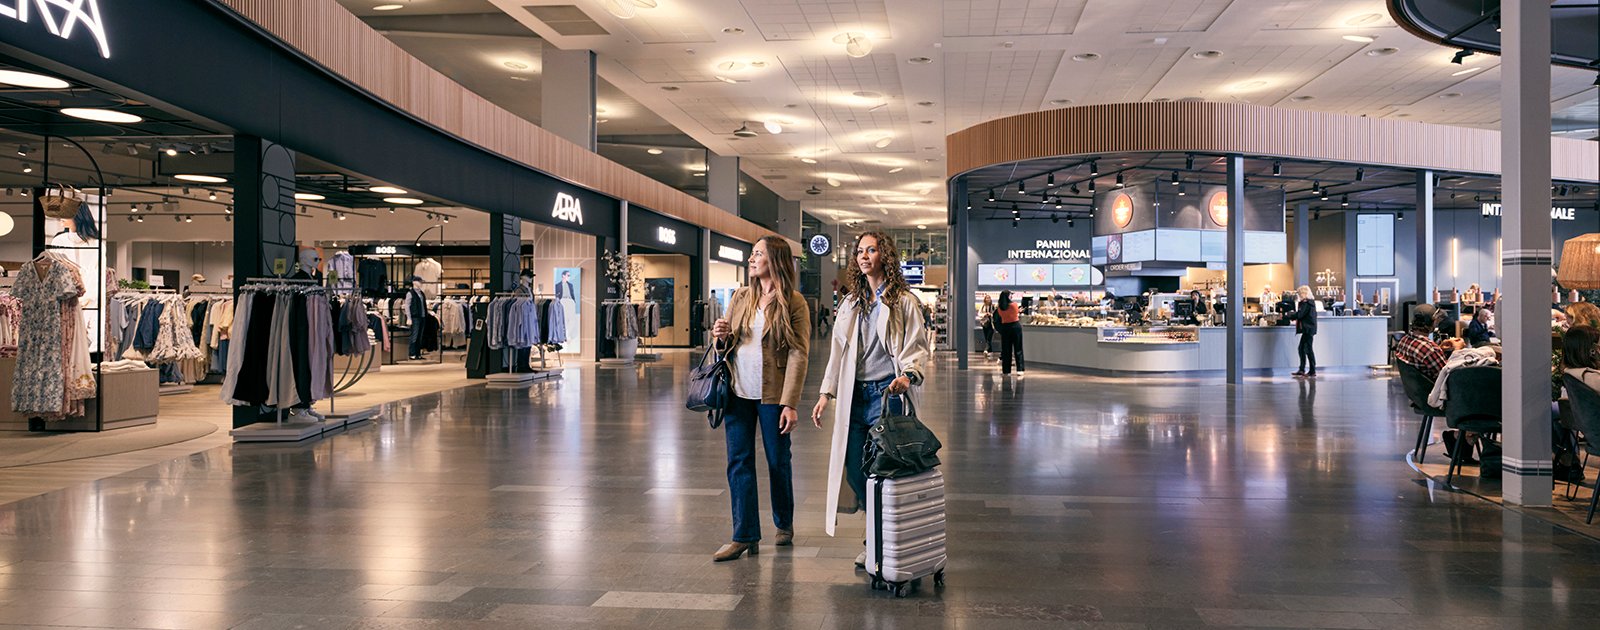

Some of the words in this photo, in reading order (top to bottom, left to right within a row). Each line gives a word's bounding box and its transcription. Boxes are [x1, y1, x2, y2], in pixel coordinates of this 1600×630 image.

[658, 226, 676, 245] BOSS
[1036, 240, 1071, 249] PANINI
[375, 246, 397, 254] BOSS
[1007, 249, 1091, 259] INTERNAZIONAL
